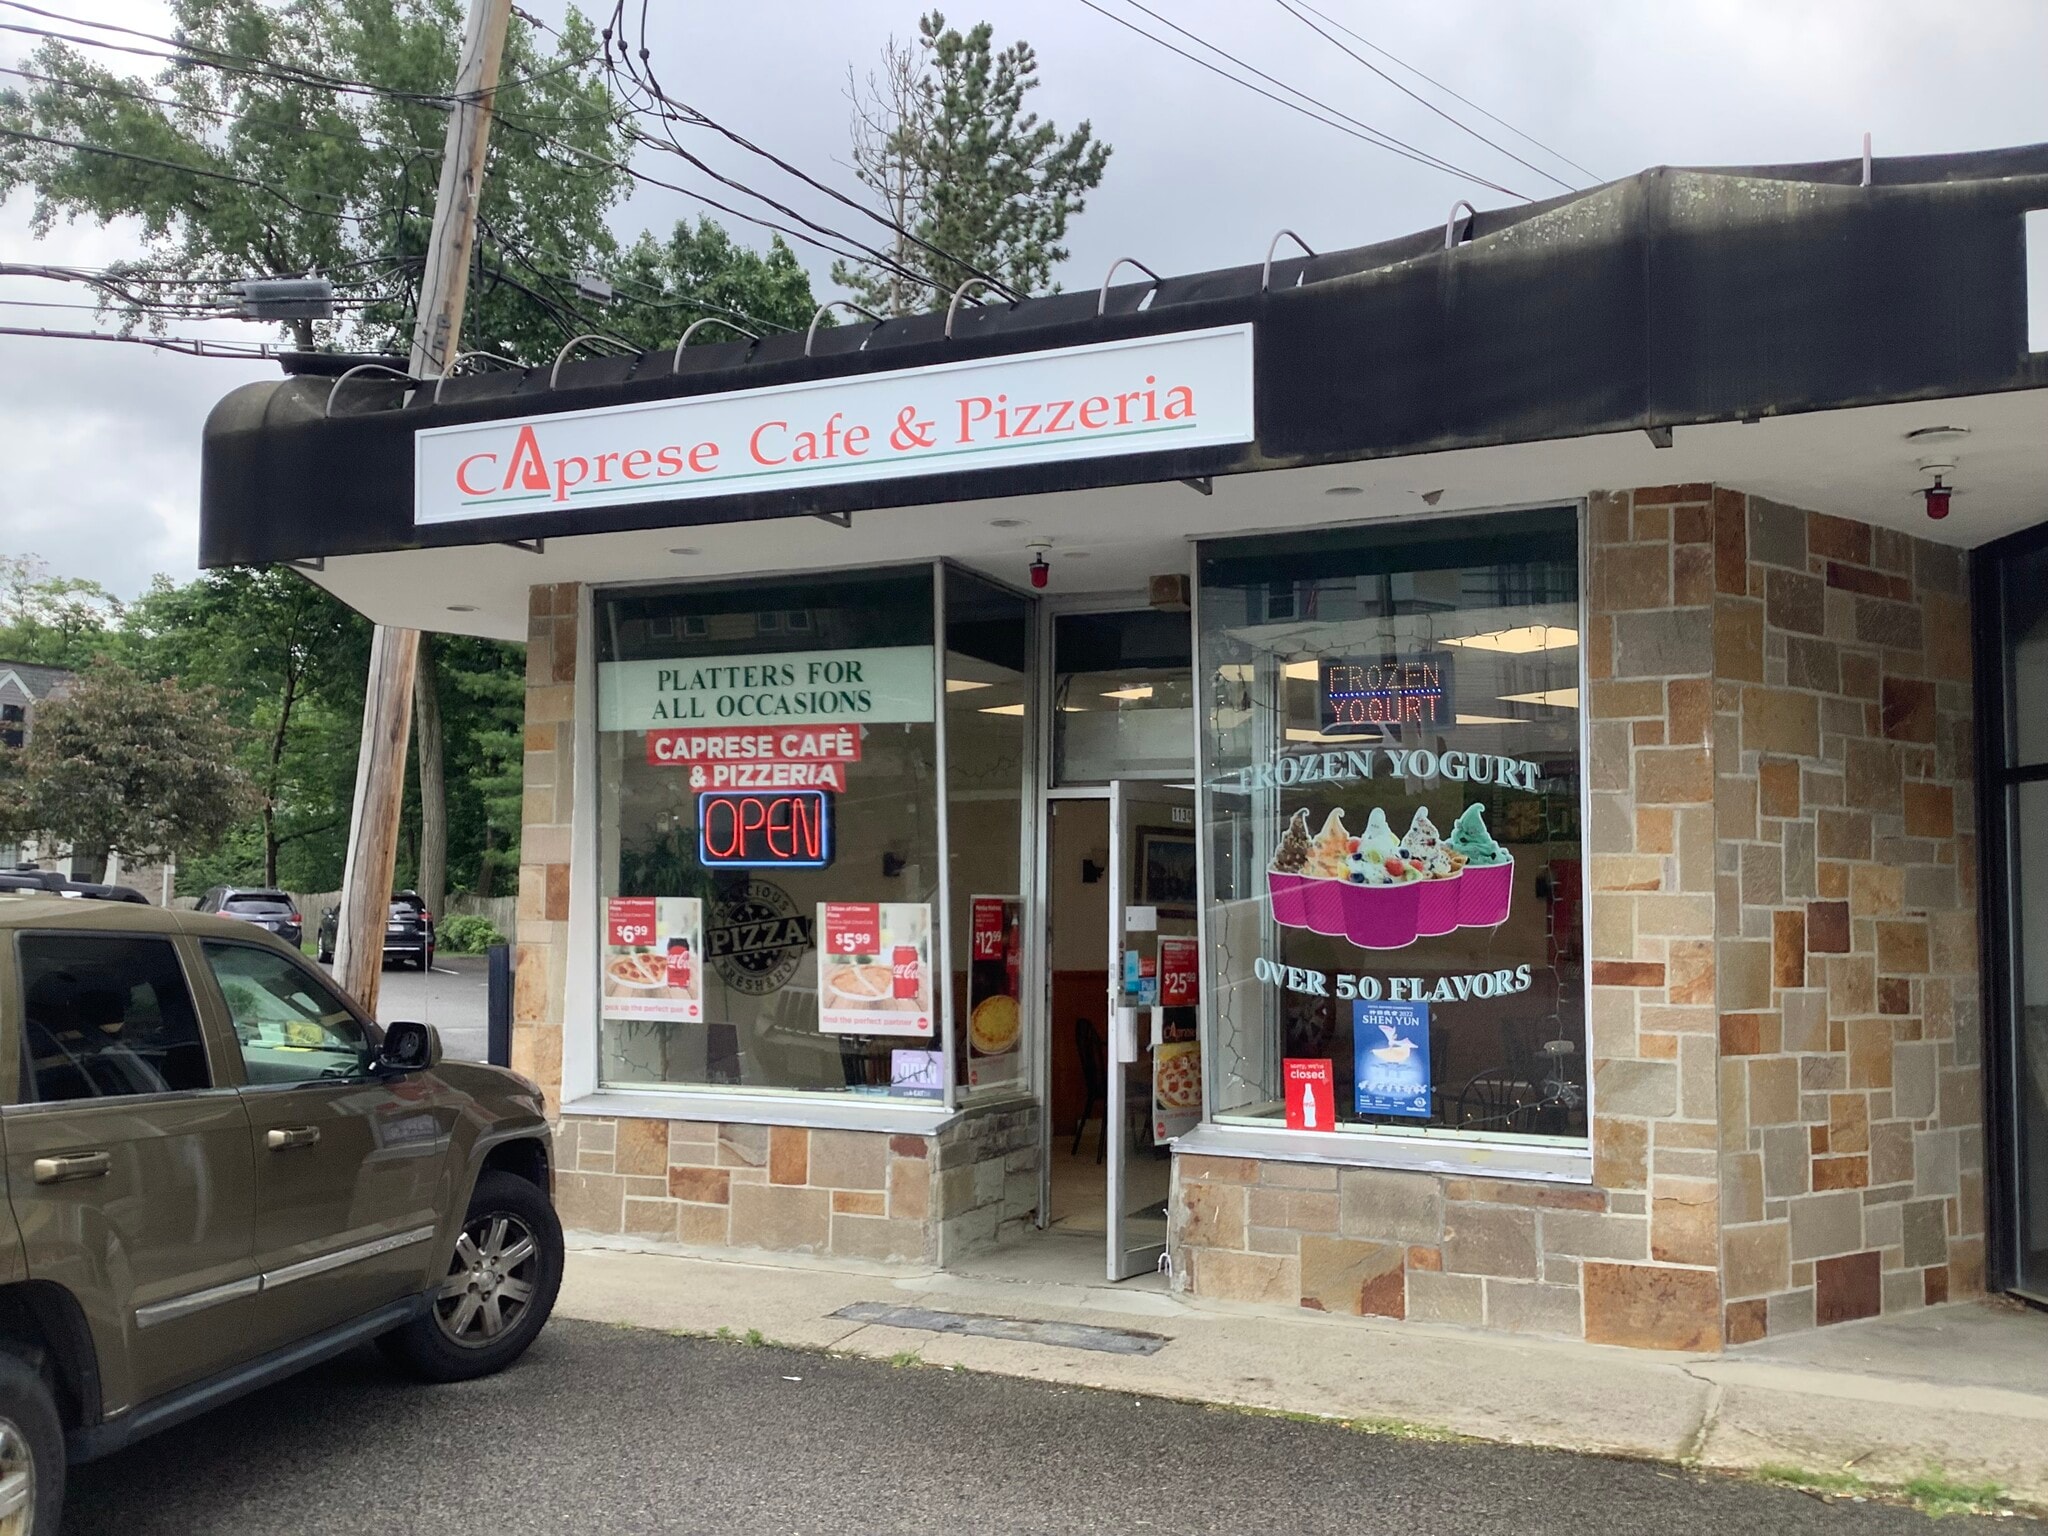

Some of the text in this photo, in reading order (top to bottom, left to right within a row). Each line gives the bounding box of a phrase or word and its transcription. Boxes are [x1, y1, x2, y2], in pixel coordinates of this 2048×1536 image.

[749, 412, 870, 465] Cafe
[889, 405, 937, 451] &
[955, 374, 1197, 444] Pizzeria
[658, 660, 863, 691] PLATTERS FOR
[1329, 661, 1441, 692] FROZEN
[651, 689, 872, 720] ALL OCCASIONS
[1329, 695, 1441, 725] YOGURT
[654, 735, 774, 760] CAPRESE
[689, 763, 838, 788] & PIZZERIA
[1238, 749, 1541, 795] FROZEN YOGURT
[705, 797, 821, 858] OPEN
[716, 885, 790, 918] DECIOUS
[709, 919, 807, 957] PIZZA
[1254, 957, 1532, 1002] OVER 50 FLAVORS
[1362, 1014, 1420, 1026] SHEN YUN
[1290, 1069, 1325, 1079] closed
